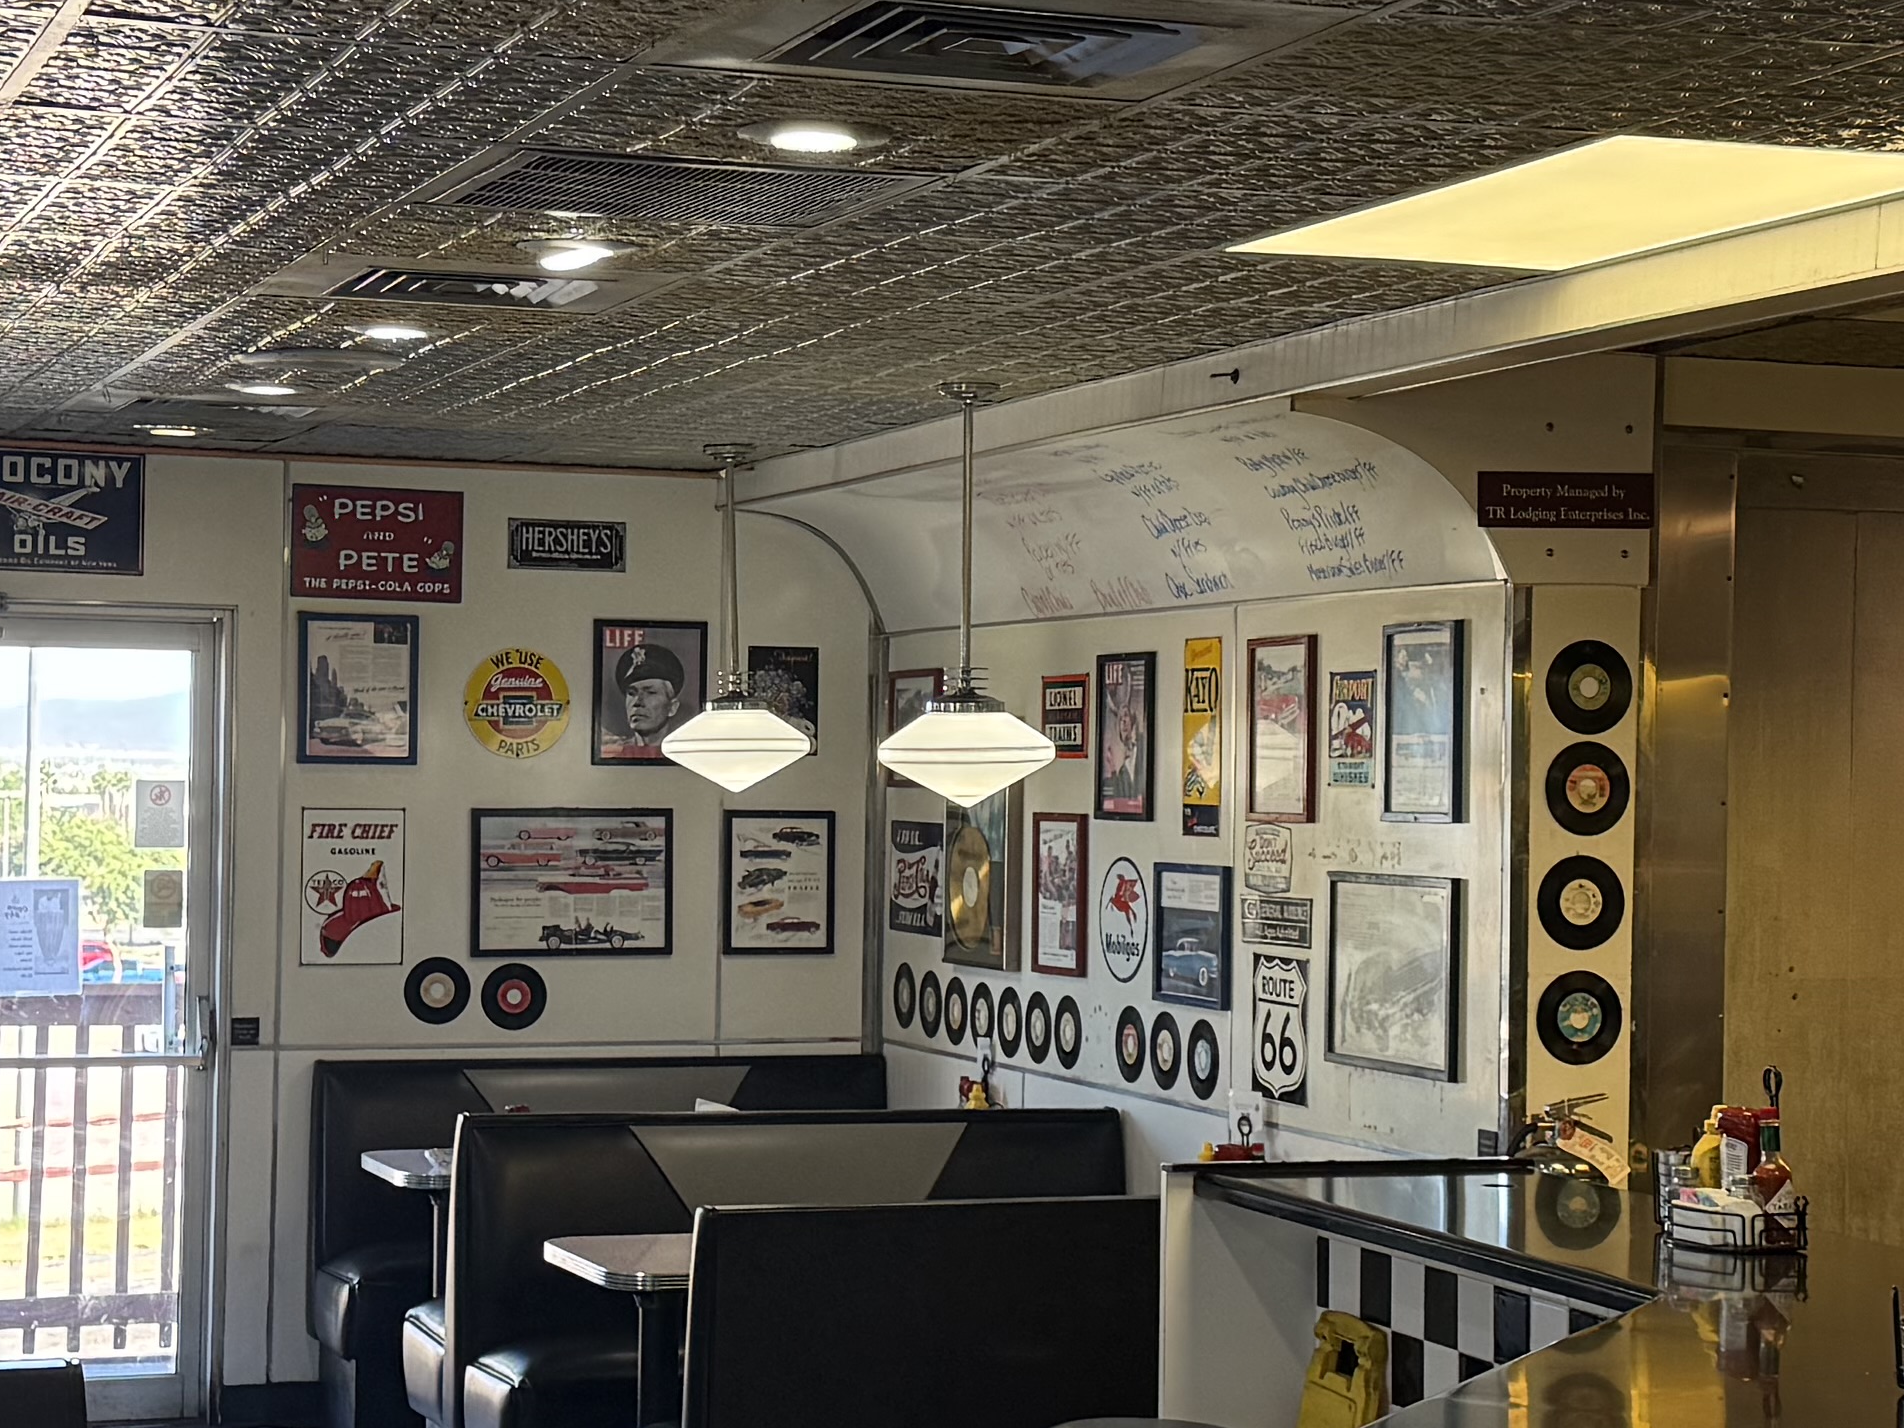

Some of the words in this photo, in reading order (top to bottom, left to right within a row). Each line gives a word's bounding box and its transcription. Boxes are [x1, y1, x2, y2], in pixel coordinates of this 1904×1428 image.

[1502, 484, 1553, 499] Property
[1556, 484, 1608, 499] Managed
[1612, 485, 1626, 500] by
[1485, 506, 1506, 519] TR
[1510, 507, 1557, 522] Lodging
[1560, 507, 1624, 522] Enterprises
[1628, 508, 1650, 520] Inc.
[14, 533, 86, 556] OILS
[363, 531, 395, 541] AND
[522, 526, 611, 553] HERSHEY'S
[303, 577, 327, 588] THE
[333, 579, 411, 592] PEPSI-COLA
[605, 629, 645, 647] LIFE
[490, 651, 513, 669] WE
[517, 651, 544, 670] USE
[1105, 663, 1124, 684] LIFE
[490, 673, 544, 692] Genuine
[1049, 690, 1077, 707] LIONEL
[477, 704, 561, 717] CHEVROLET
[496, 738, 540, 755] PARTS
[307, 823, 347, 839] FIRE
[351, 823, 398, 840] CHIEF
[330, 847, 376, 855] GASOLINE
[1105, 932, 1140, 962] Mobilgas
[1261, 976, 1295, 999] ROUTE
[1261, 1008, 1297, 1076] 66
